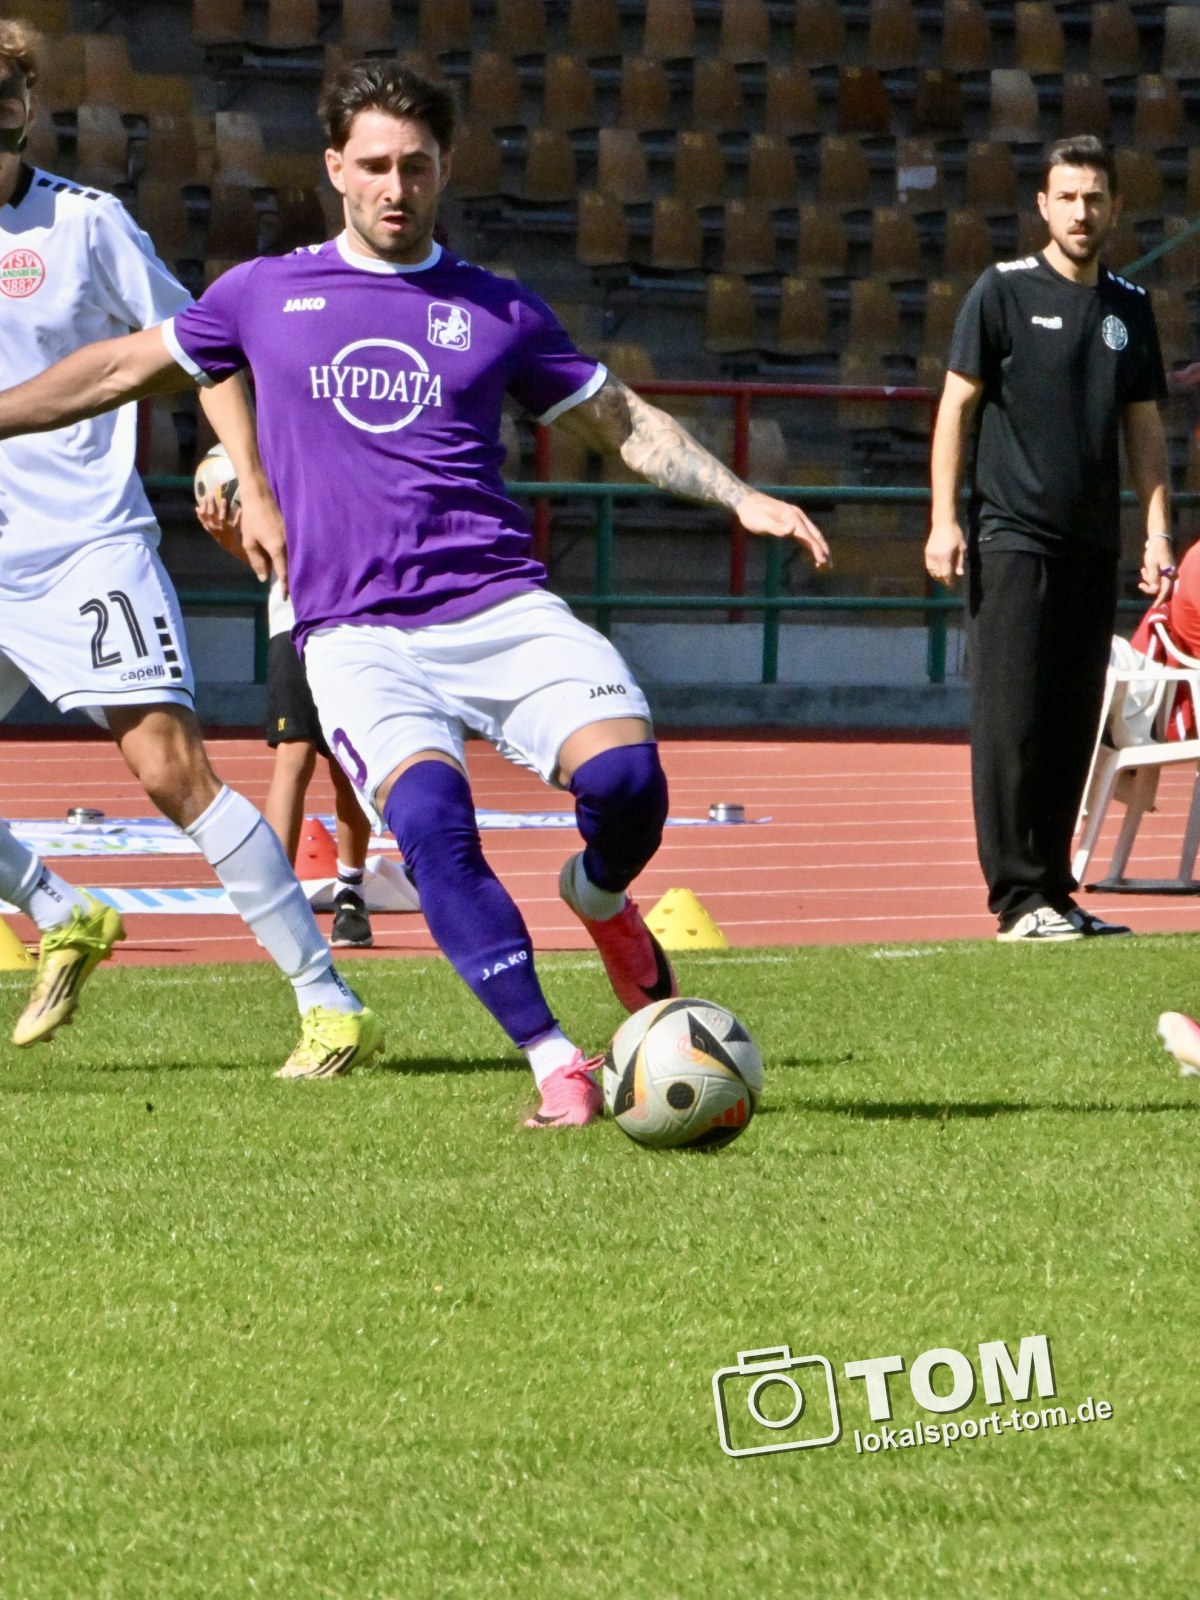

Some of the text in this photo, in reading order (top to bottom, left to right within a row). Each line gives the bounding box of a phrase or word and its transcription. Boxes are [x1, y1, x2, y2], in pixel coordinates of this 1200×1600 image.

[4, 252, 38, 268] TSV
[283, 297, 326, 312] JAKO
[309, 364, 443, 408] HYPDATA
[79, 590, 149, 669] 21
[120, 664, 166, 681] capelli
[589, 684, 627, 699] JAKO
[482, 950, 528, 981] JAKO
